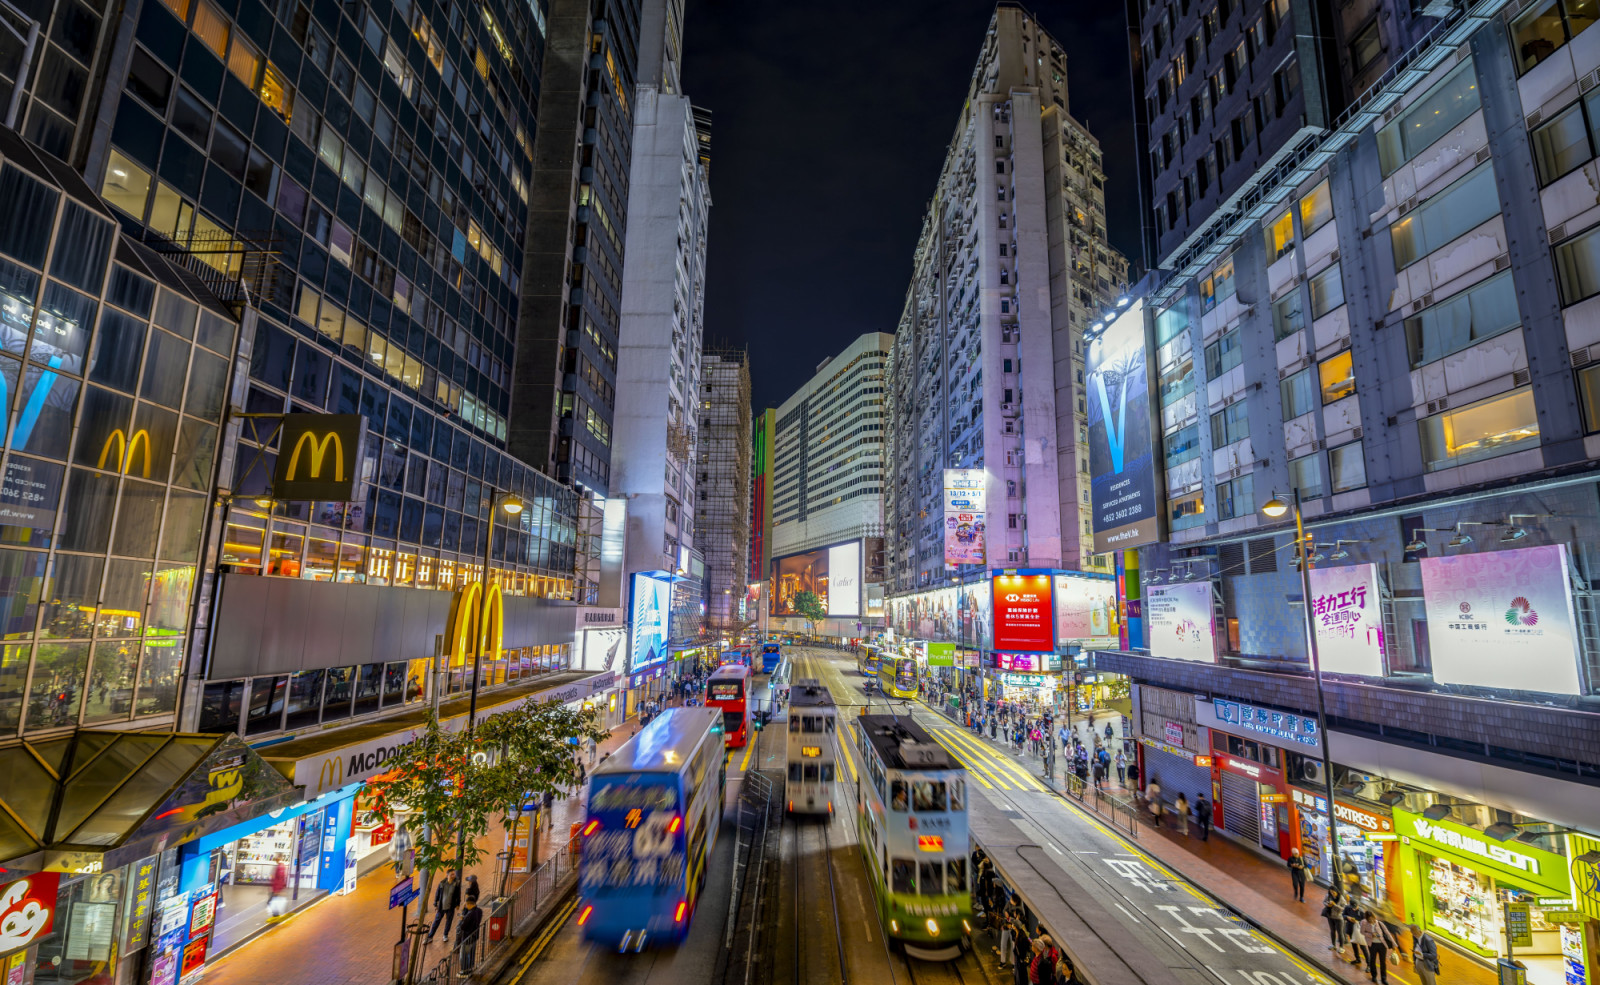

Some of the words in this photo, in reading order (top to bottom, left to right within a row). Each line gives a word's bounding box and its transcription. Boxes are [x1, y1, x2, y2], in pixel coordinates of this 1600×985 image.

[1103, 512, 1115, 523] +852
[1115, 508, 1128, 520] 3602
[1128, 503, 1142, 516] 2388
[1312, 585, 1367, 617] 活力工行
[1321, 610, 1362, 626] 全運同心
[918, 751, 935, 764] 20
[1333, 803, 1378, 830] ORTRESS
